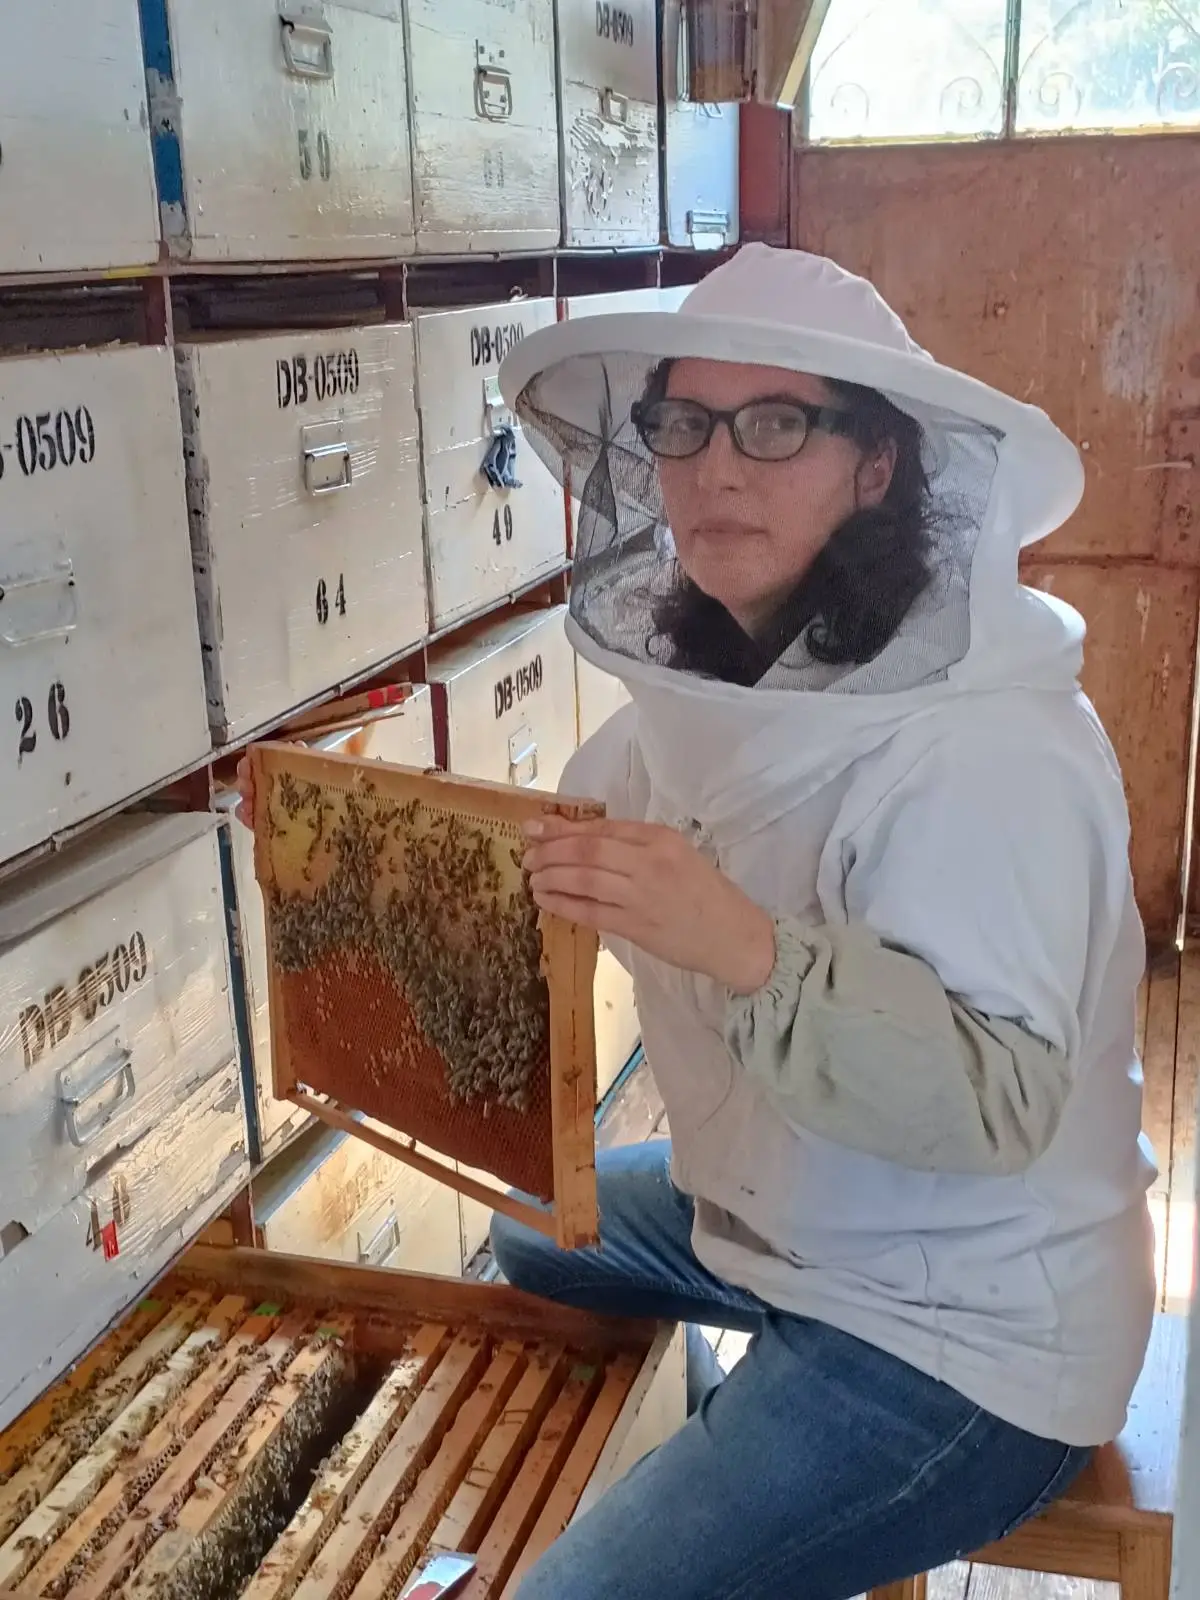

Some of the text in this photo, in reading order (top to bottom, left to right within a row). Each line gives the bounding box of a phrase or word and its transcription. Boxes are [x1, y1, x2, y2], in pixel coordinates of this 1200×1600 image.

[275, 347, 359, 409] DB-0509
[0, 405, 95, 480] -0509
[492, 504, 512, 545] 40
[316, 573, 346, 625] 64
[495, 654, 542, 719] DB-0509
[15, 683, 69, 757] 26
